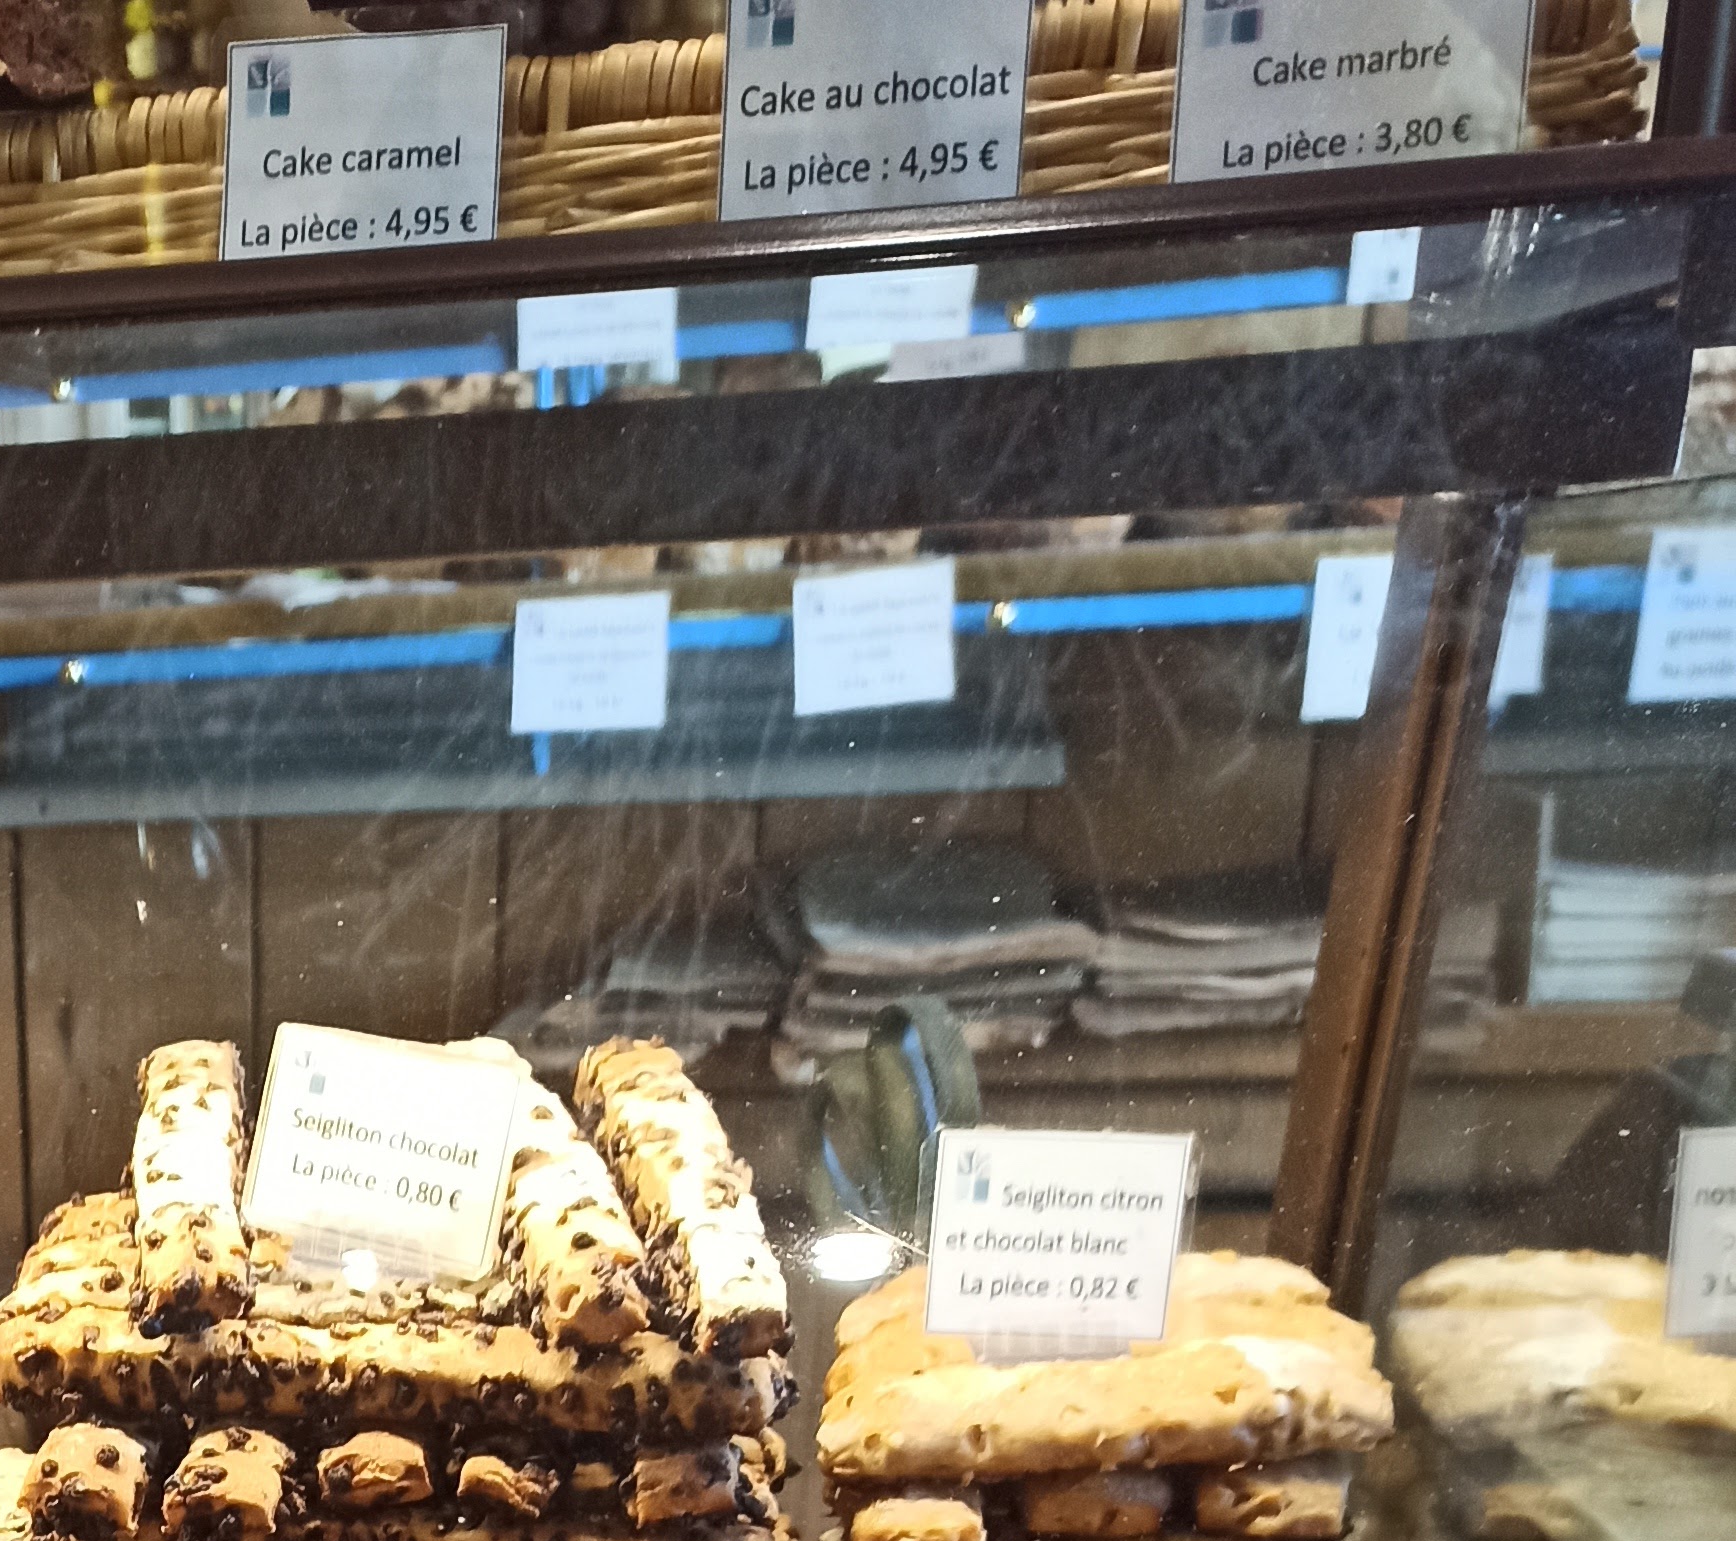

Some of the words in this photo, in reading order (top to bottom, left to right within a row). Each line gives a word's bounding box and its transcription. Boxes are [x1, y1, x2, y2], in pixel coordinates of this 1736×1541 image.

[1253, 51, 1327, 87] Cake
[1336, 34, 1452, 78] marbré
[740, 81, 816, 117] Cake
[825, 83, 863, 110] au
[874, 64, 1012, 105] chocolat
[263, 146, 332, 178] Cake
[342, 135, 461, 173] caramel
[744, 159, 776, 191] La
[787, 152, 871, 195] pièce
[899, 141, 968, 184] 4,95
[979, 139, 999, 172] €
[1222, 140, 1254, 169] La
[1264, 129, 1346, 170] pièce
[1374, 116, 1442, 156] 3,80
[1452, 113, 1472, 144] €
[241, 219, 270, 248] La
[281, 212, 358, 252] pièce
[385, 205, 450, 241] 4,95
[460, 203, 479, 233] €
[292, 1107, 382, 1144] Seigliton
[389, 1131, 479, 1169] chocolat
[292, 1153, 314, 1176] La
[320, 1163, 377, 1191] pièce
[396, 1175, 443, 1207] 0,80
[448, 1189, 463, 1213] €
[1002, 1183, 1094, 1214] Seigliton
[1100, 1186, 1164, 1211] citron
[945, 1230, 967, 1250] et
[973, 1228, 1064, 1254] chocolat
[1070, 1229, 1128, 1256] blanc
[959, 1271, 982, 1296] La
[990, 1272, 1049, 1301] pièce
[1069, 1276, 1117, 1303] 0,82
[1126, 1277, 1139, 1300] €
